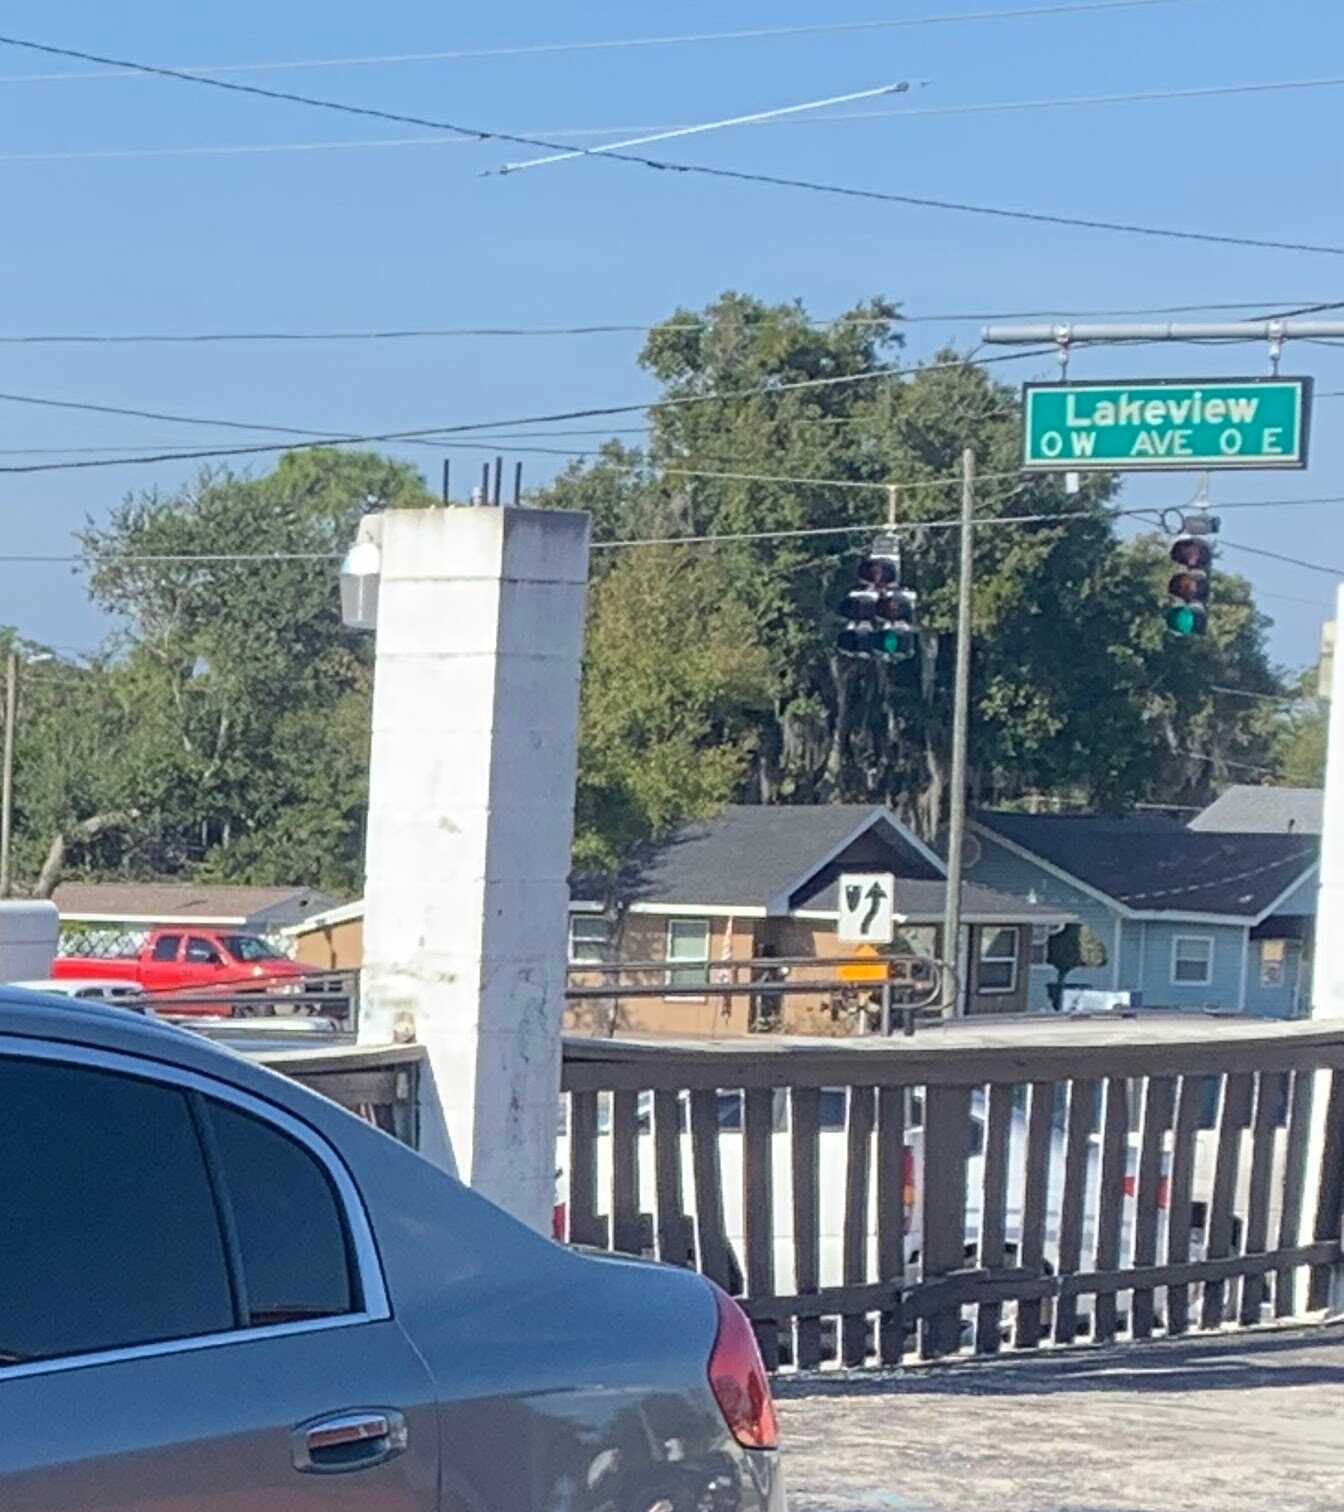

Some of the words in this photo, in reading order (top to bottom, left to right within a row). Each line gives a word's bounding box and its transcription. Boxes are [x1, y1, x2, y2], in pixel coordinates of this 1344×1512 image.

[1065, 391, 1260, 427] Lakeview
[1129, 429, 1194, 456] AVE
[1262, 427, 1284, 454] E
